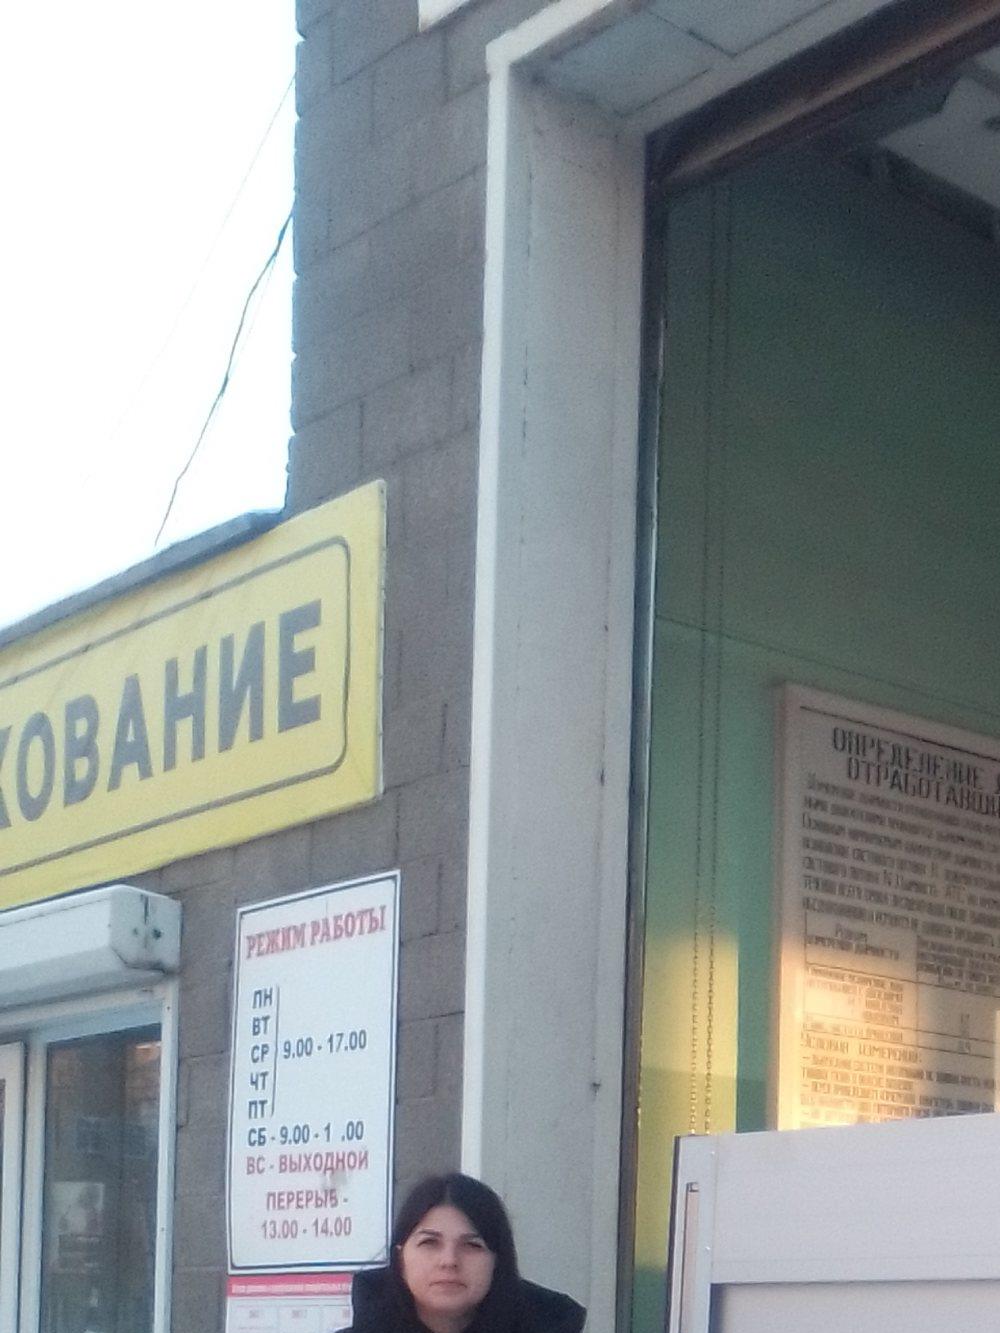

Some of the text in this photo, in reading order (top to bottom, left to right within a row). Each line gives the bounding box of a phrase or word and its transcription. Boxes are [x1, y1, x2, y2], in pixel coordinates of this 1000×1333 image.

[246, 905, 387, 959] РЕЖИМ РАБОТЫ
[252, 987, 273, 1009] ПН
[252, 1015, 270, 1036] ВТ
[251, 1043, 270, 1063] СР
[283, 1037, 313, 1059] 9.00
[327, 1030, 367, 1053] 17.00
[250, 1071, 268, 1092] ЧТ
[248, 1100, 268, 1119] ПТ
[248, 1127, 266, 1147] СБ
[279, 1124, 310, 1145] 9.00
[246, 1155, 266, 1175] ВС
[279, 1148, 369, 1175] ВЫХОДНОЙ
[266, 1189, 338, 1211] ПЕРЕРЫВ
[261, 1219, 298, 1240] 13.00
[313, 1217, 352, 1238] 14.00
